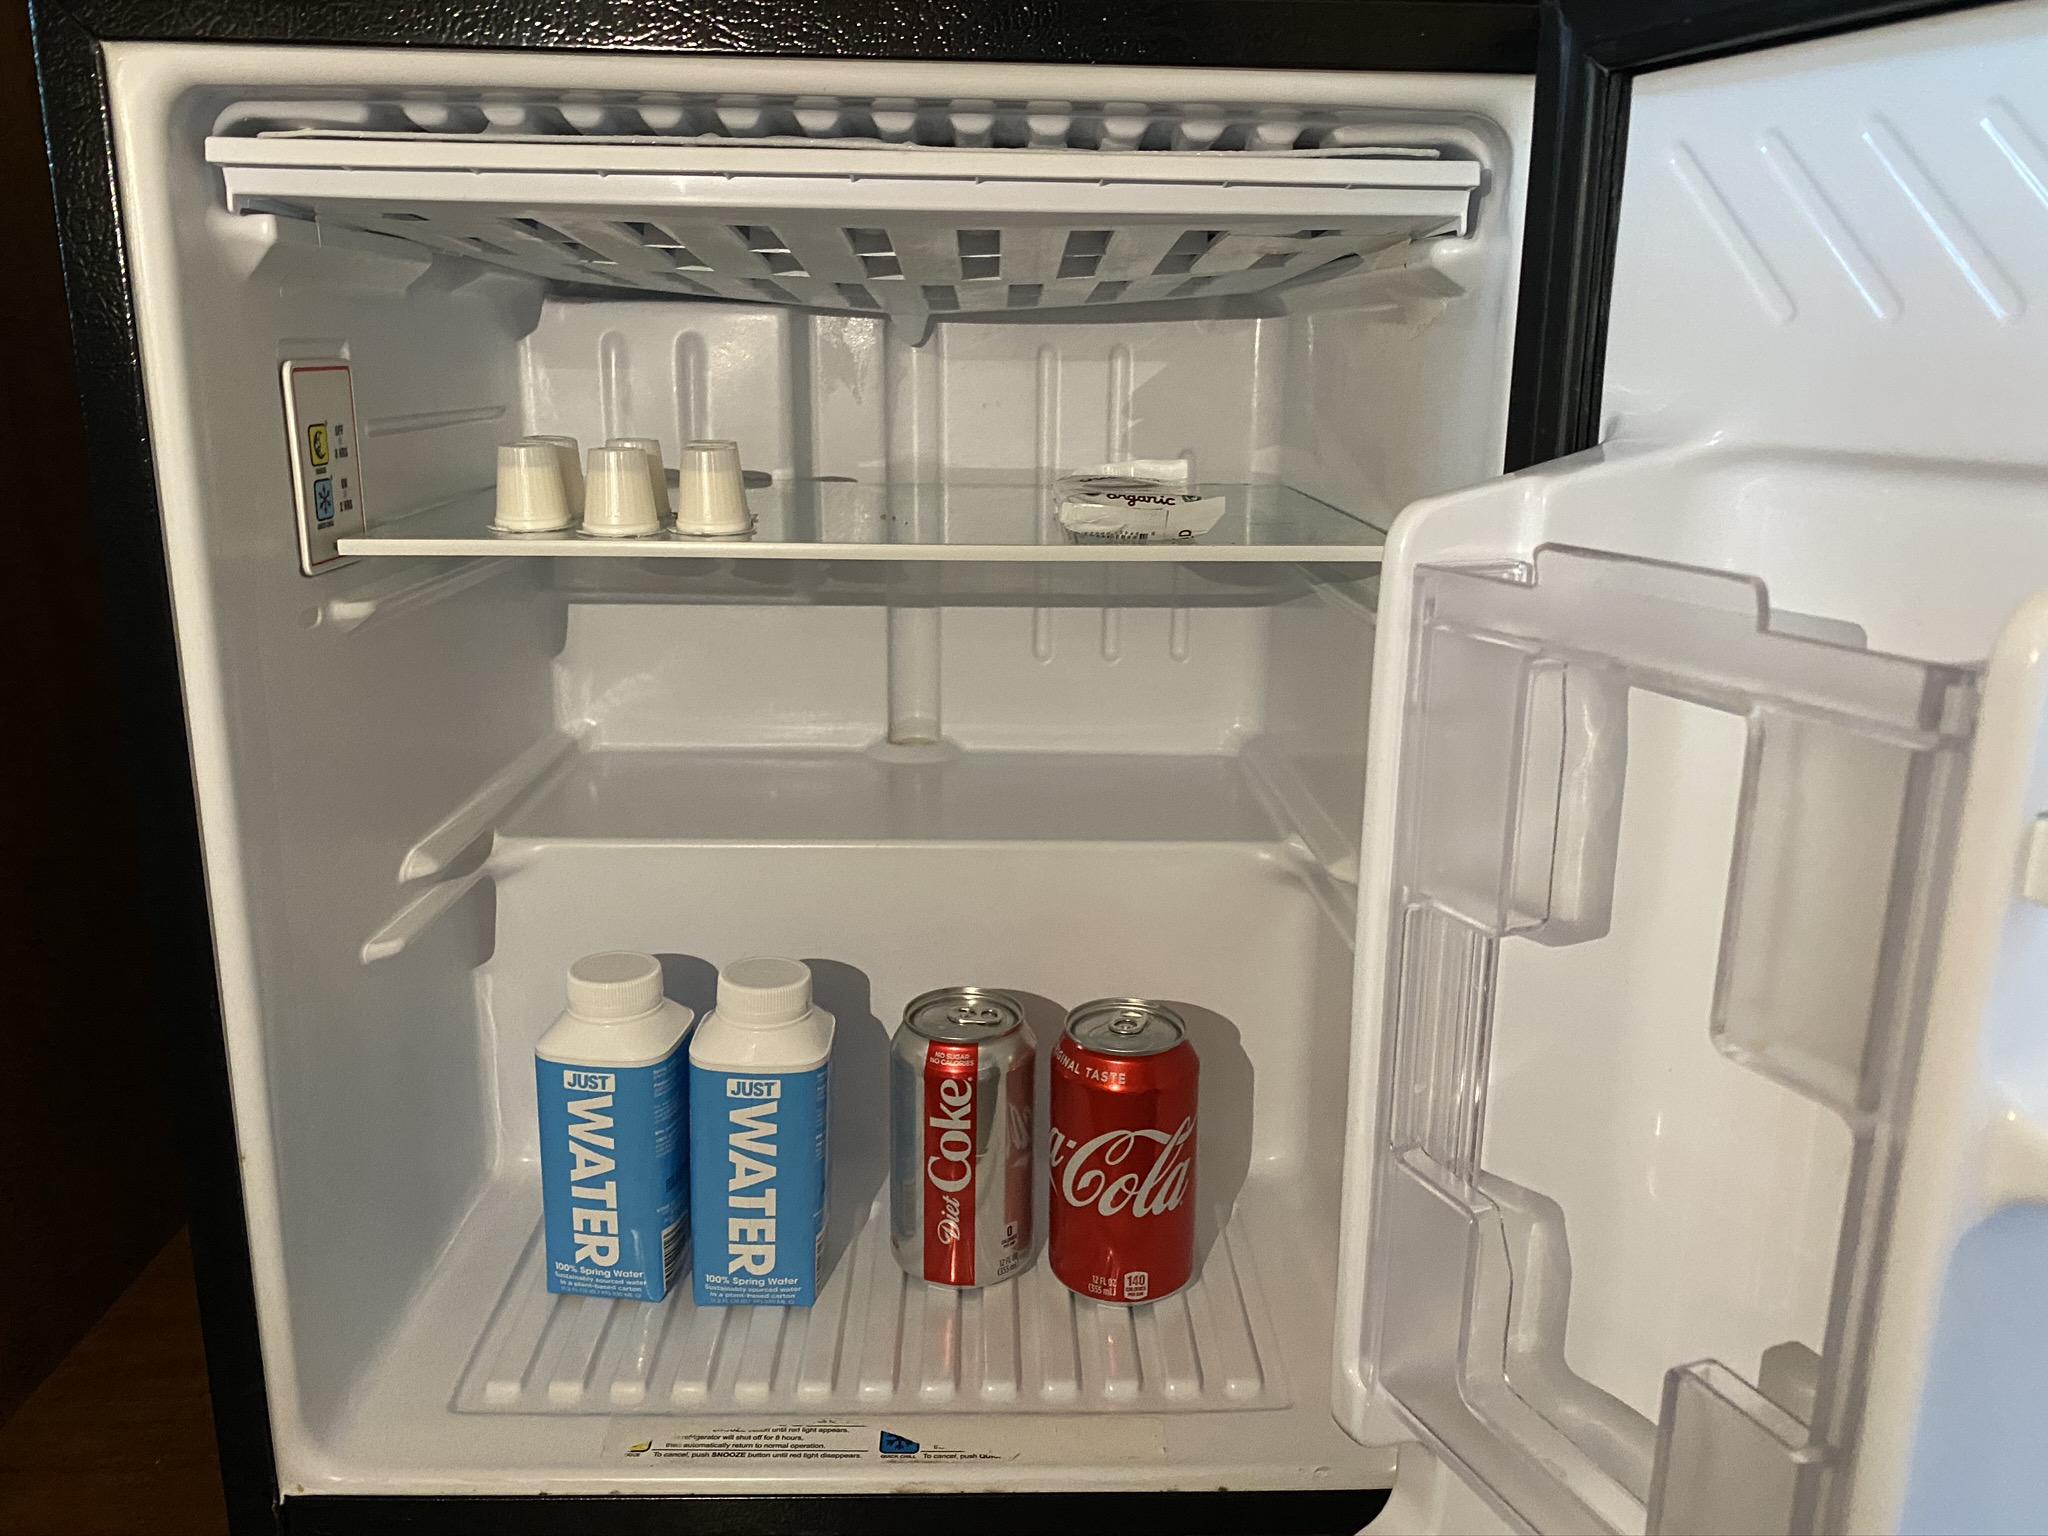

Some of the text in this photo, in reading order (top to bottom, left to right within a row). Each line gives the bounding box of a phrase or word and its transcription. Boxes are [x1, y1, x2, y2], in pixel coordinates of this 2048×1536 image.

[1106, 493, 1176, 506] organic
[930, 1056, 974, 1067] NO CALORIES
[935, 1051, 945, 1059] NO
[567, 1073, 609, 1091] JUST
[1085, 1067, 1126, 1086] TASTE
[730, 1081, 775, 1098] JUST
[928, 1077, 973, 1245] Diet Coke
[567, 1094, 619, 1267] WATER
[728, 1101, 778, 1276] WATER
[555, 1261, 644, 1278] 100% Spring Water
[554, 1271, 594, 1282] Sustainably
[595, 1277, 624, 1285] sourced
[705, 1274, 798, 1287] 100% Spring Water
[1092, 1275, 1099, 1285] 12
[1100, 1276, 1107, 1286] FL
[1127, 1274, 1146, 1287] 140
[574, 1281, 617, 1290] plant-based
[704, 1284, 746, 1292] Sustainably
[1088, 1283, 1102, 1294] (355
